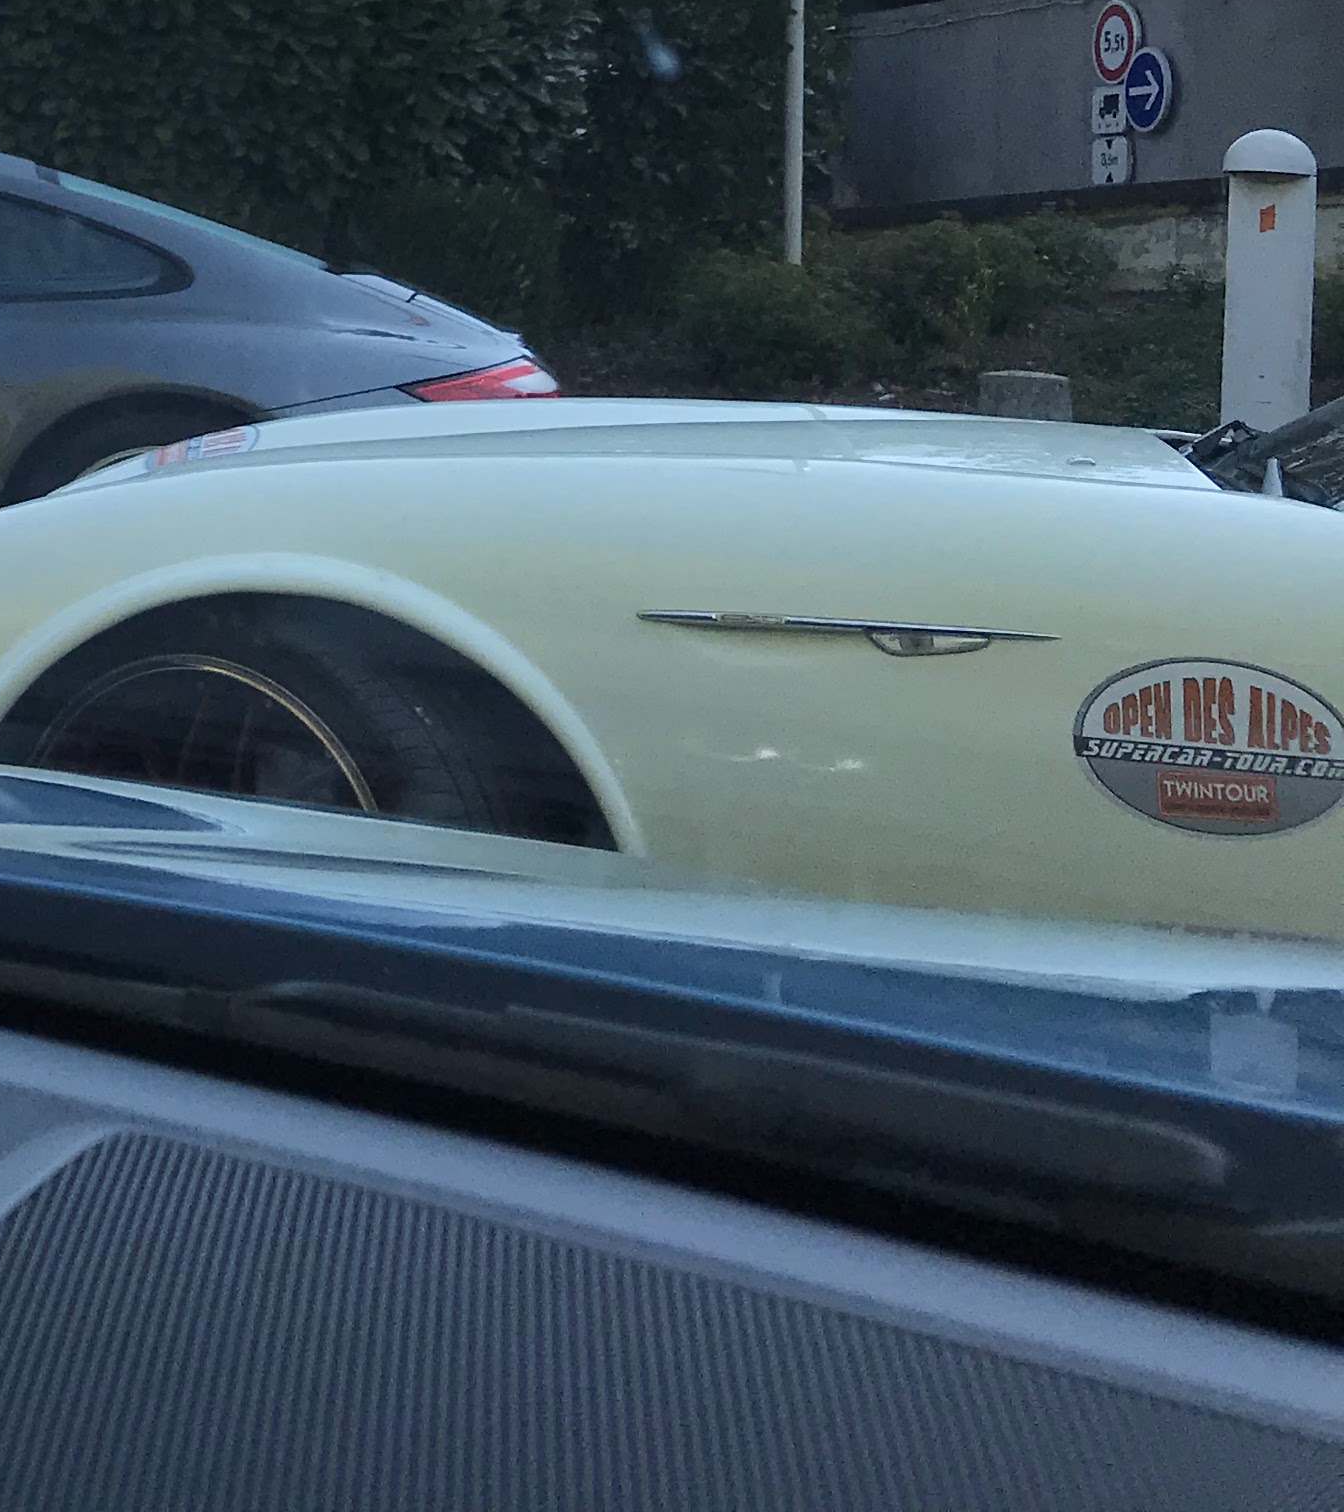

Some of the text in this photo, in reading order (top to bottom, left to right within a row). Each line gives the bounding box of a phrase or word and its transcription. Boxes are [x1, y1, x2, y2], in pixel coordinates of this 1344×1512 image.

[1103, 676, 1331, 755] OPEN DES ALPES
[1163, 779, 1270, 804] TWINTOUR
